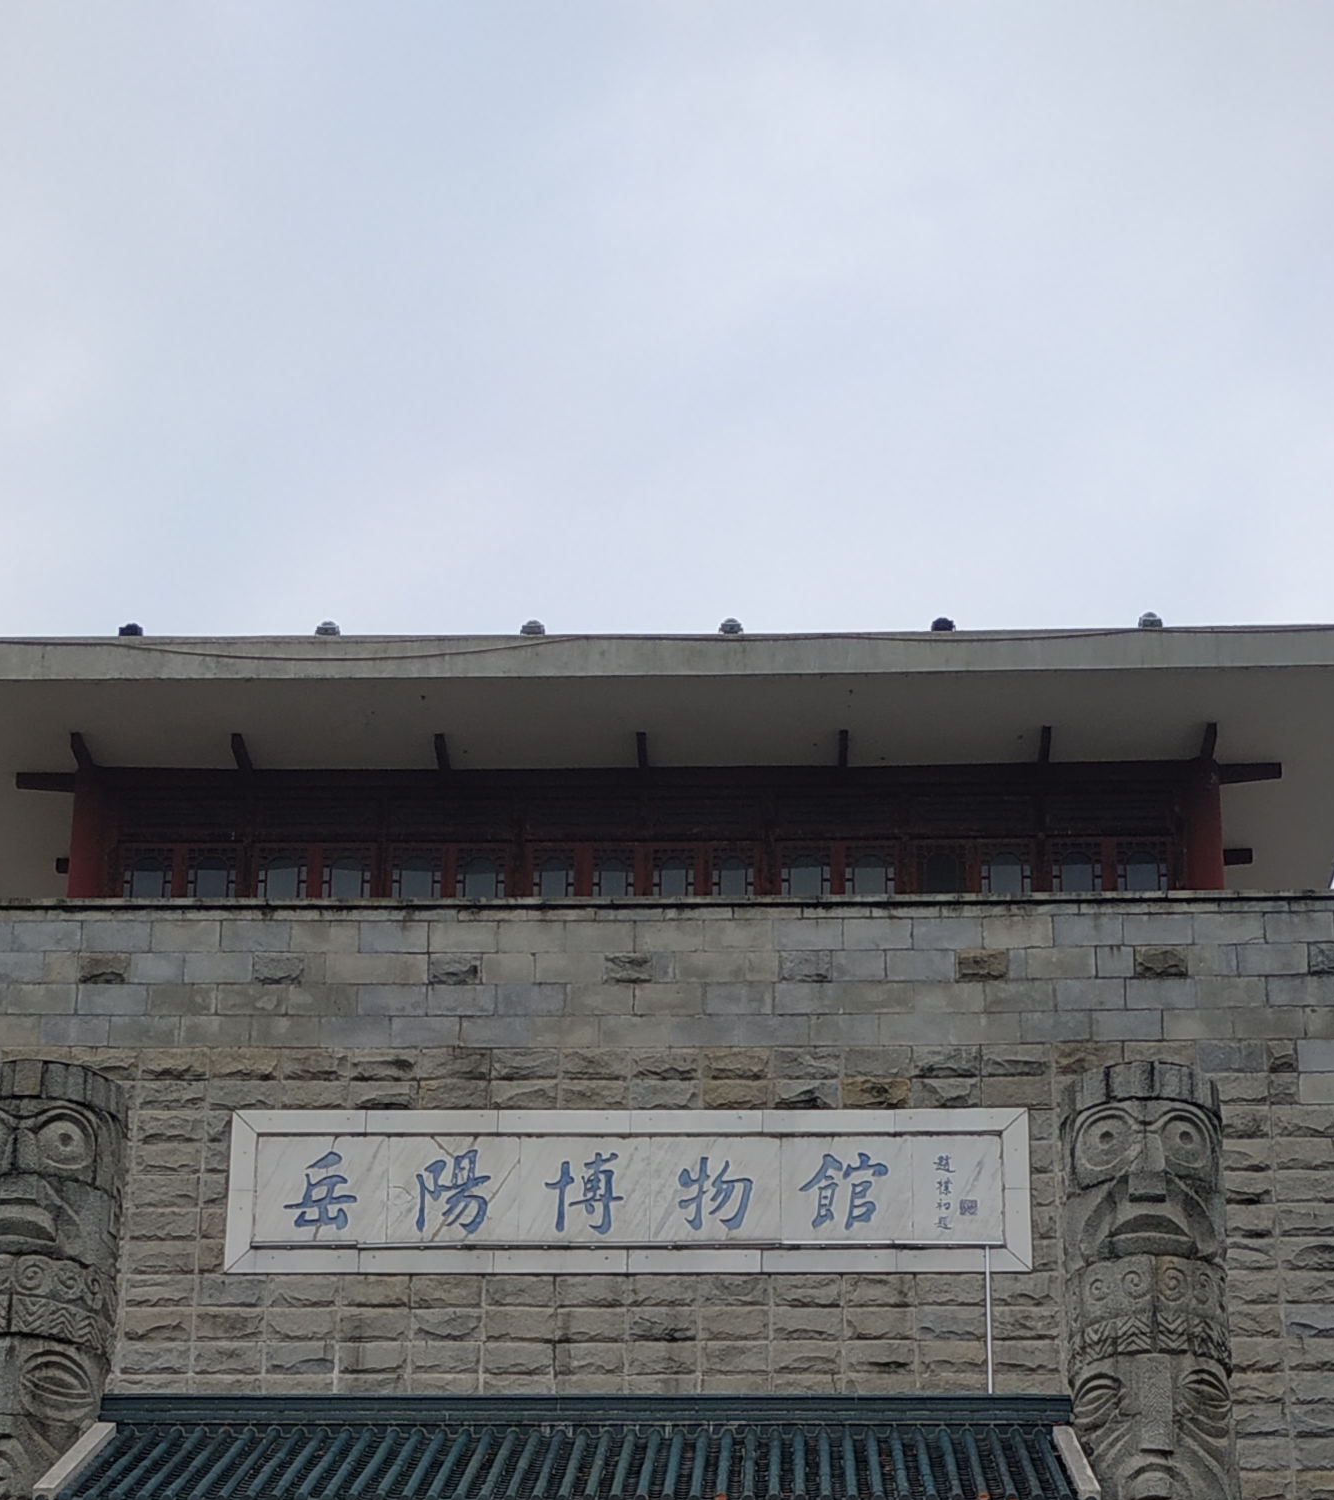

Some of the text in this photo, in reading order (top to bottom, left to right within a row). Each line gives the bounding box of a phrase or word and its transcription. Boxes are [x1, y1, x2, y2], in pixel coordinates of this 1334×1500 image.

[283, 1150, 890, 1235] 岳陽博物館
